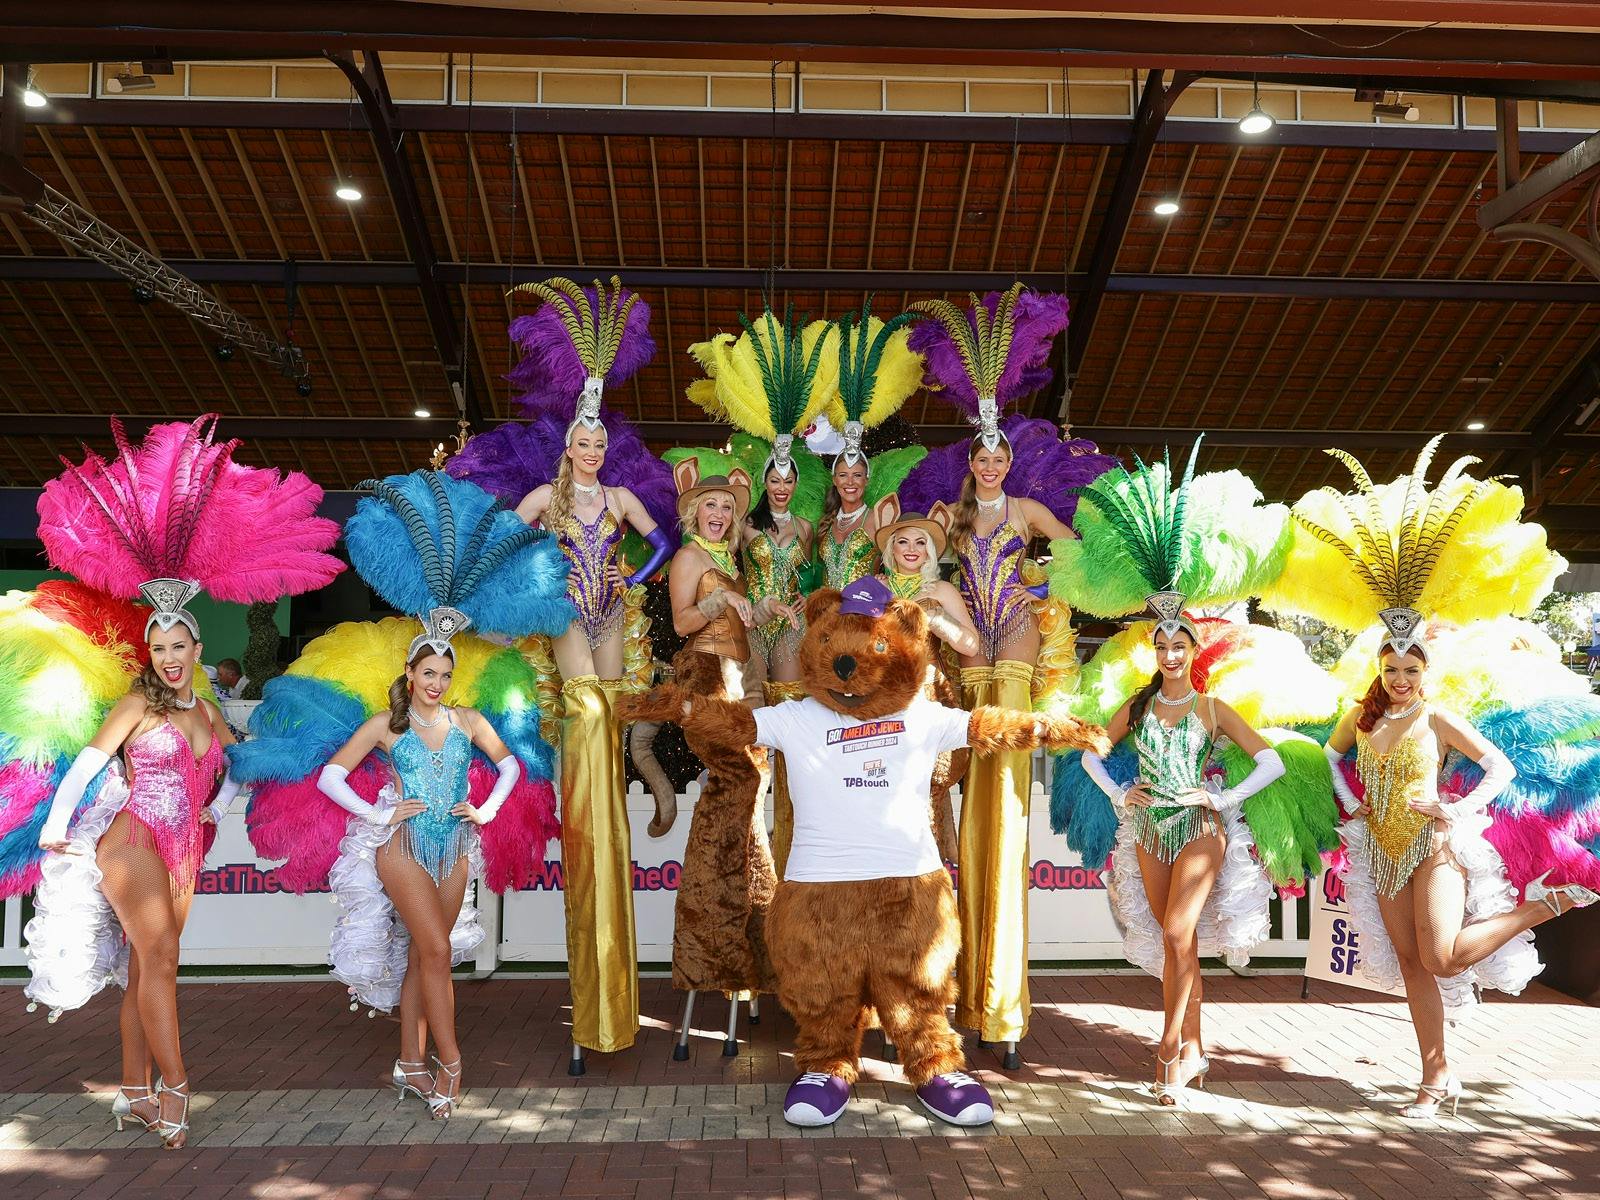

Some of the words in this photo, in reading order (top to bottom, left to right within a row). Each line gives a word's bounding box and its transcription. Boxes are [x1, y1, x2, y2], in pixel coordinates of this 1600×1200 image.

[827, 729, 842, 744] GO!
[842, 722, 877, 741] AMELIA'S
[878, 721, 904, 735] JEWEL
[843, 777, 889, 788] TABtouch
